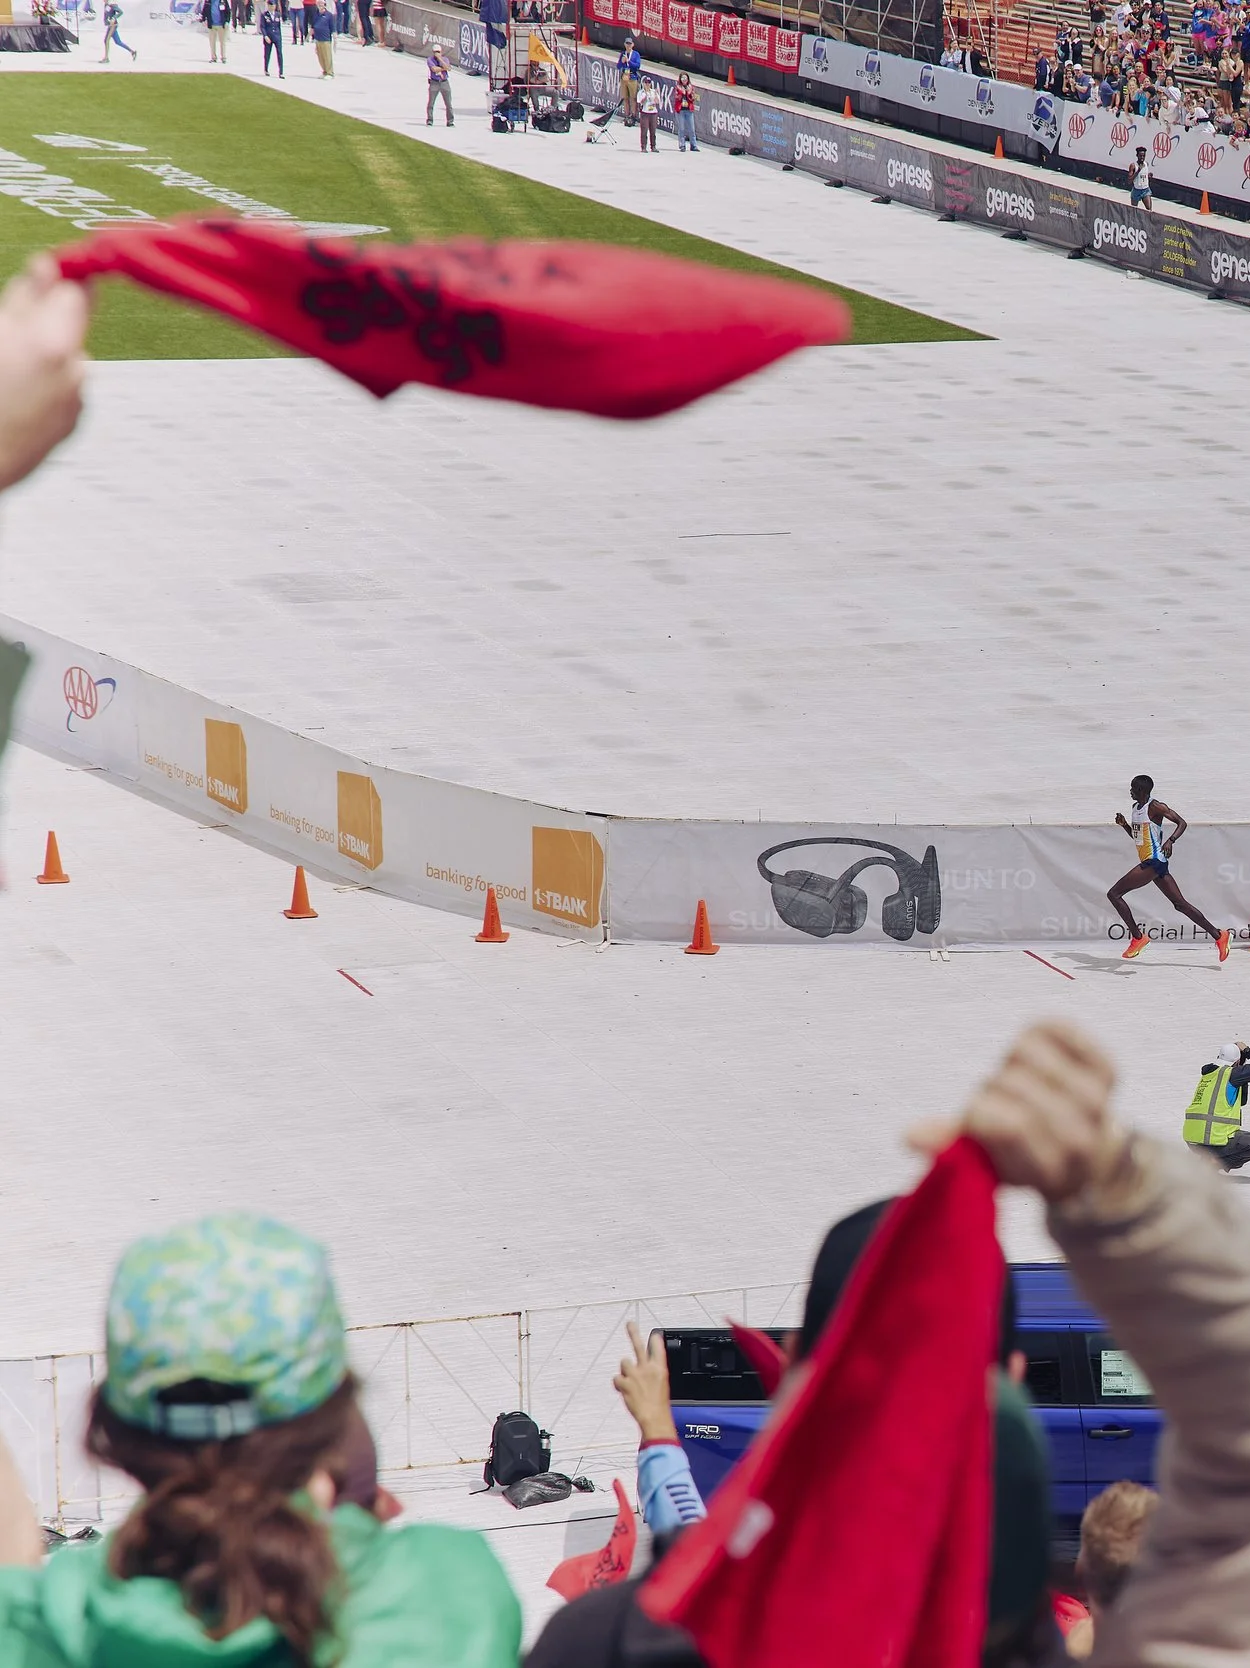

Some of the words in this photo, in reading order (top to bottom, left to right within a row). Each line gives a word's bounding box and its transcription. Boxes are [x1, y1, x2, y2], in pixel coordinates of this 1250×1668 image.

[711, 108, 751, 138] genesis
[795, 132, 838, 163] genesis
[887, 158, 933, 191] genesis
[986, 187, 1035, 221] genesis
[1093, 217, 1148, 254] genesis
[64, 667, 97, 719] AAA
[144, 748, 173, 779] banking
[173, 763, 185, 780] for
[185, 772, 204, 788] good
[270, 804, 301, 834] banking
[302, 817, 314, 834] for
[315, 826, 335, 844] good
[426, 862, 474, 892] banking
[475, 874, 493, 892] for
[496, 883, 527, 902] good
[936, 868, 1037, 890] UUNTO
[534, 887, 588, 918] 1STBANK
[685, 1424, 720, 1434] TRD
